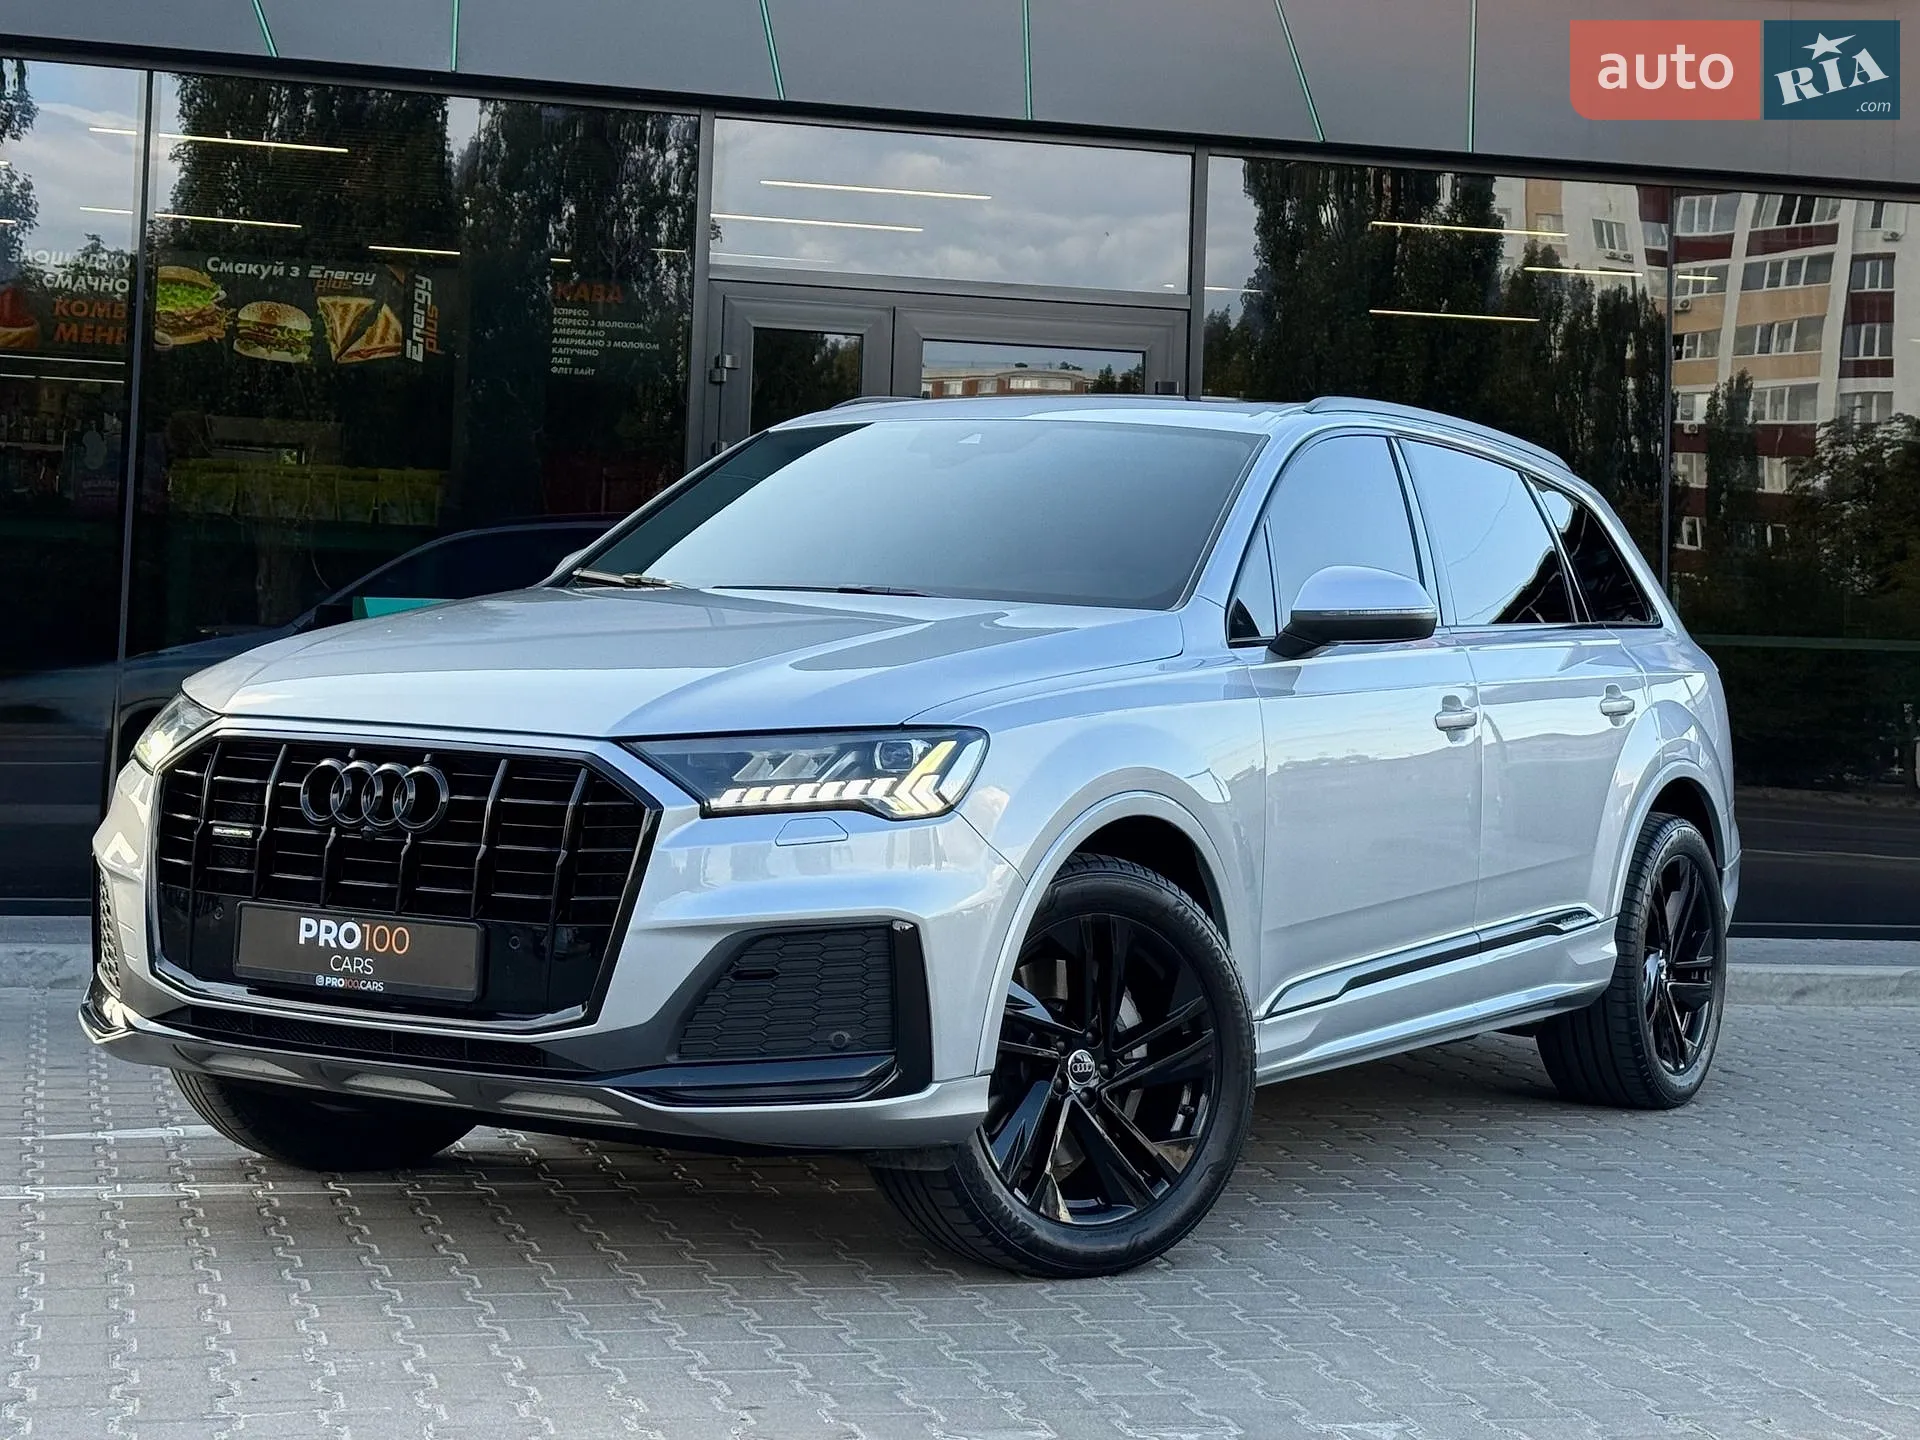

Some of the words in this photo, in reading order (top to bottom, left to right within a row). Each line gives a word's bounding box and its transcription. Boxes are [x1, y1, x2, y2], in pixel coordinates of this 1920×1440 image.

[206, 256, 284, 279] Смакуй
[308, 265, 377, 286] Energy
[42, 274, 130, 292] СМАЧНО
[405, 274, 433, 363] Energy
[553, 307, 590, 317] ЕСПРЕСО
[425, 304, 446, 354] plus
[552, 317, 589, 327] ЕСПРЕСО
[597, 320, 644, 330] МОЛОКОМ
[552, 327, 606, 338] АМЕРИКАНО
[551, 337, 605, 348] АМЕРИКАНО
[613, 341, 660, 350] МОЛОКОМ
[551, 347, 600, 357] КАПУЧИНО
[550, 357, 572, 365] ЛАТЕ
[298, 917, 411, 954] PRO100
[330, 955, 374, 975] CARS
